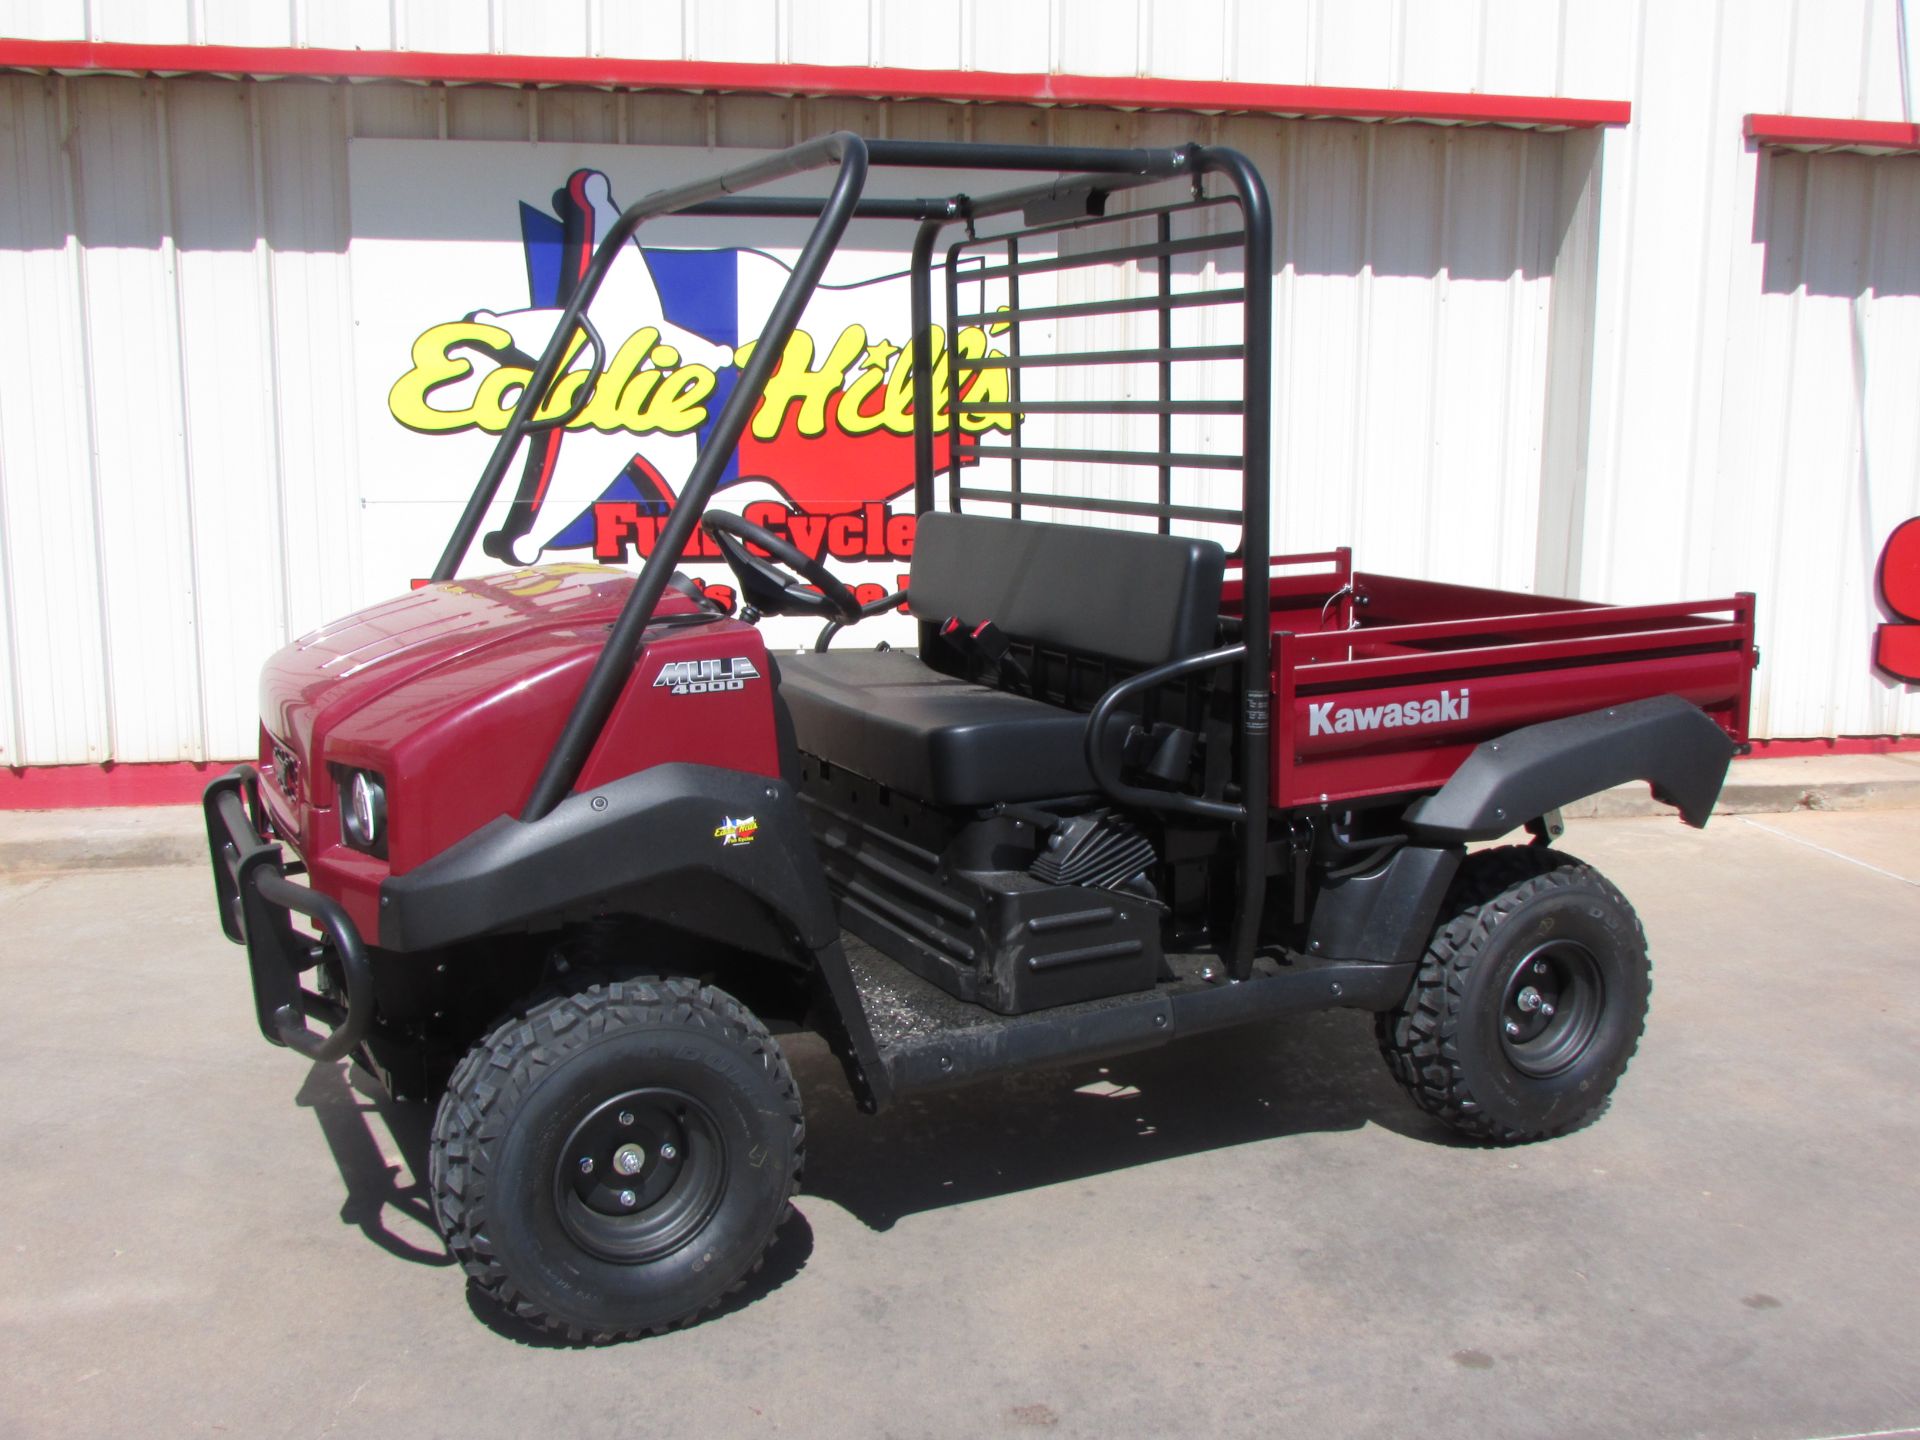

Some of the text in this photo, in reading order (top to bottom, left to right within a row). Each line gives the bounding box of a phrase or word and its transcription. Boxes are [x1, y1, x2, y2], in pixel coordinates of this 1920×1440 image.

[388, 305, 1024, 440] Eddie Hill's
[653, 657, 760, 687] MULE
[671, 679, 744, 695] 4000
[1309, 688, 1469, 736] Kawasaki
